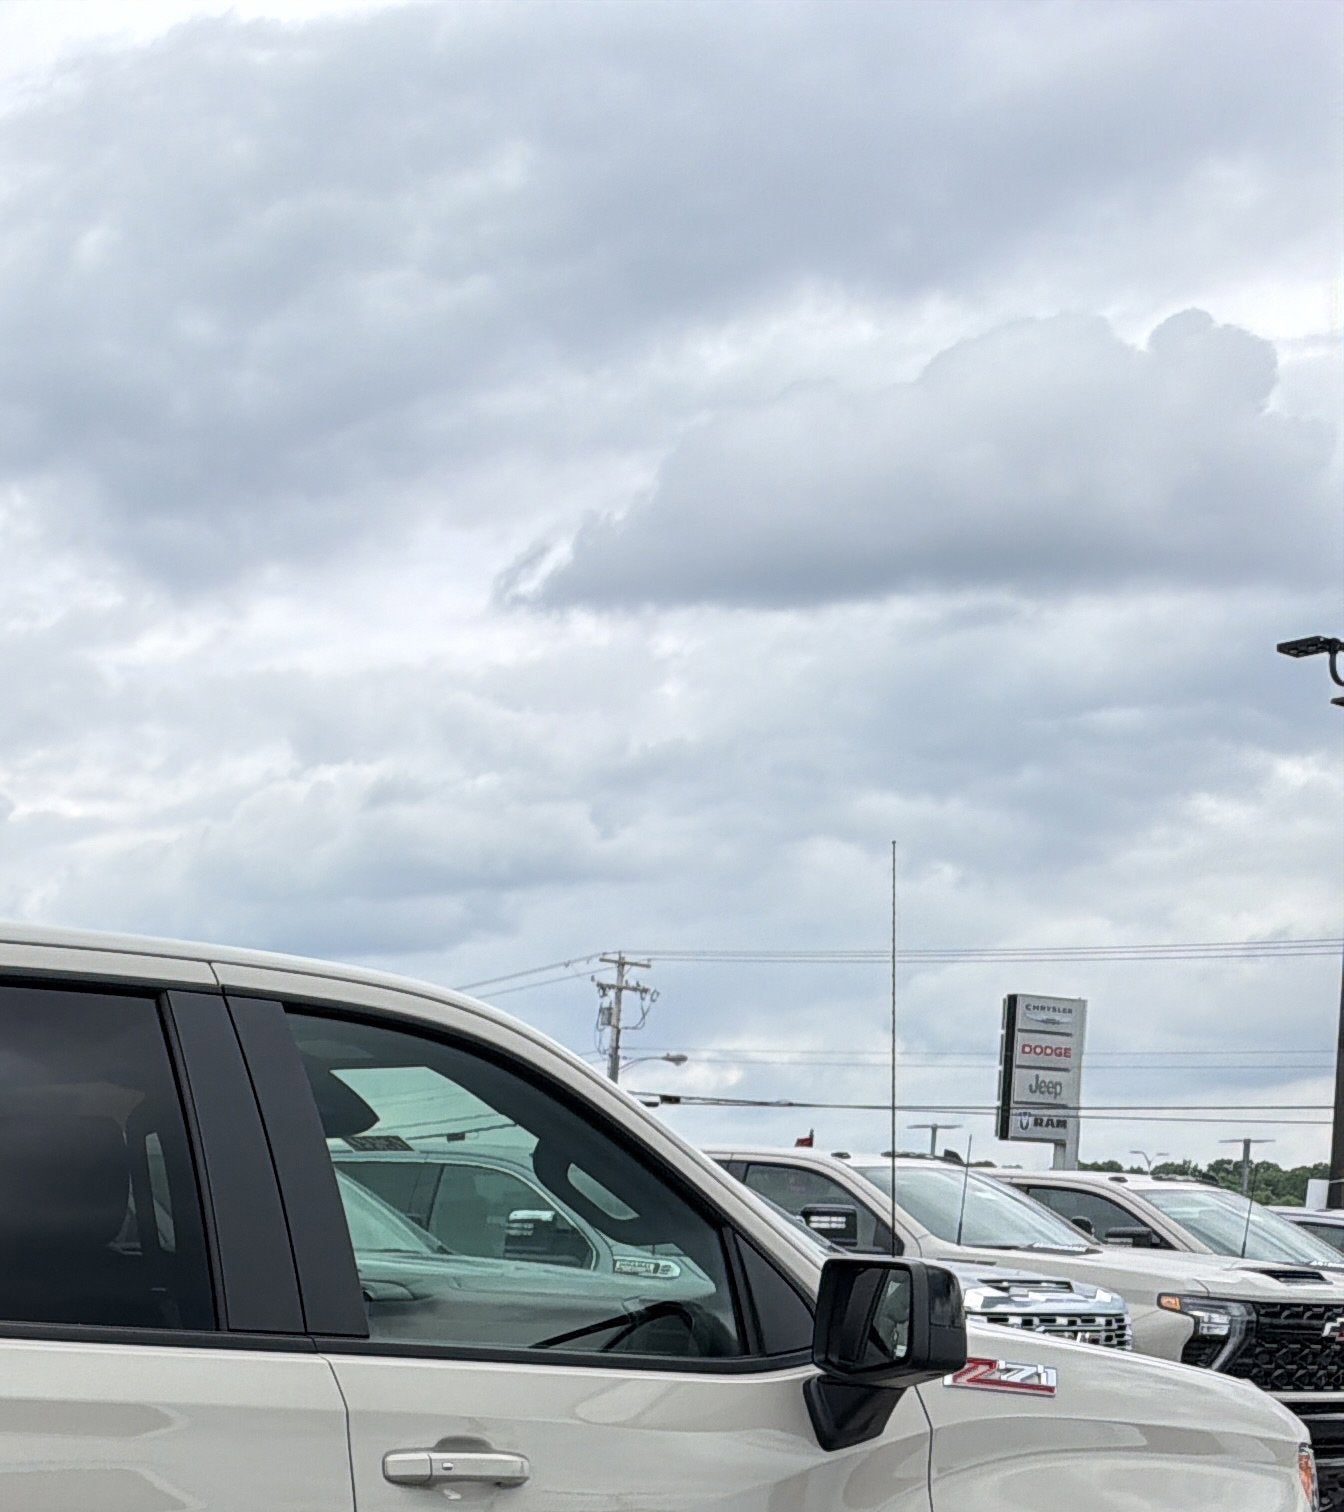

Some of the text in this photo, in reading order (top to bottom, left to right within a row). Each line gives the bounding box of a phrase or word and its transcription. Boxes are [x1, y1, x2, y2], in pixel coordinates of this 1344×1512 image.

[1025, 1003, 1073, 1014] CHRYSLER
[1021, 1044, 1072, 1058] DODGE
[1028, 1074, 1063, 1098] Jeep
[1033, 1117, 1068, 1129] RAM
[943, 1357, 1058, 1398] Z71
